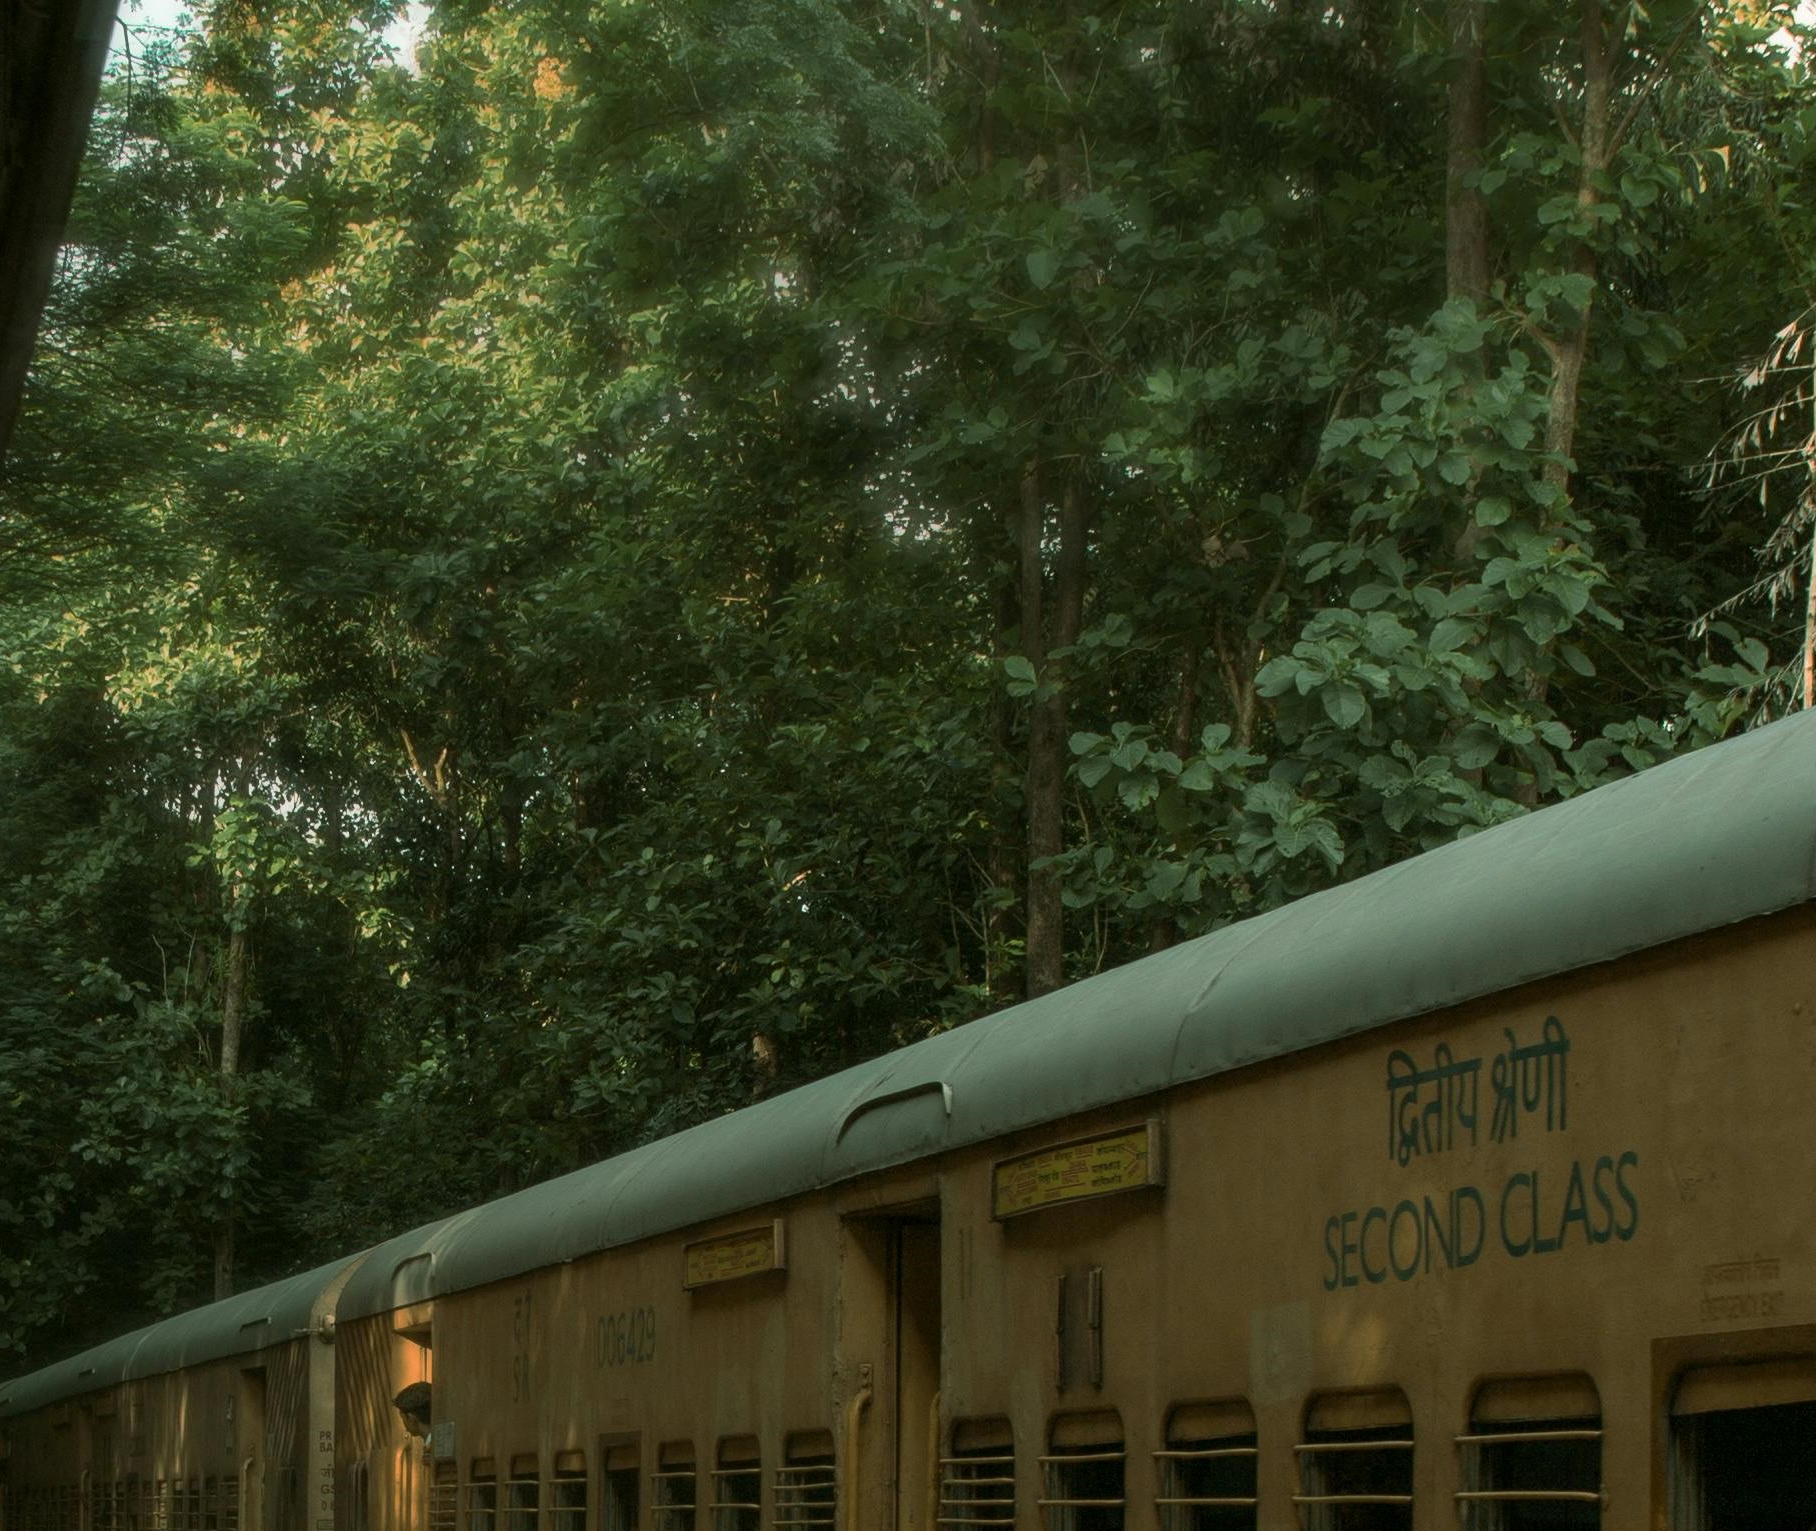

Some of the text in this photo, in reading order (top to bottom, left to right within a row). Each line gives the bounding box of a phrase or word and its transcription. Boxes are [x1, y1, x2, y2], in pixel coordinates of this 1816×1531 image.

[1490, 1015, 1571, 1145] श्रेणी
[1323, 1150, 1640, 1292] SECOND CLASS
